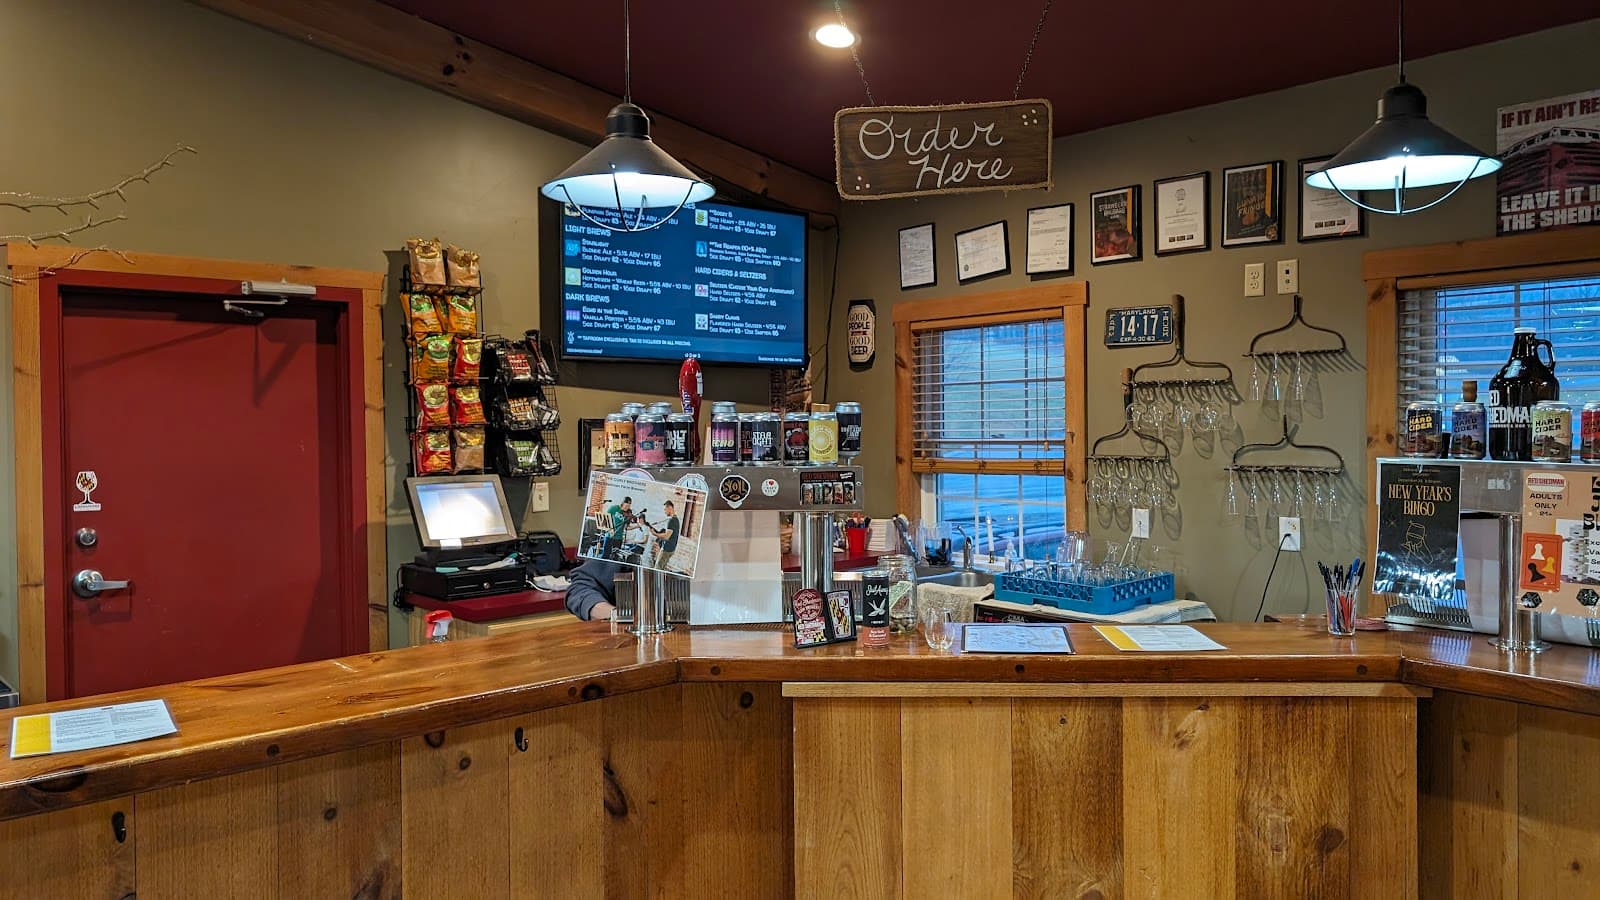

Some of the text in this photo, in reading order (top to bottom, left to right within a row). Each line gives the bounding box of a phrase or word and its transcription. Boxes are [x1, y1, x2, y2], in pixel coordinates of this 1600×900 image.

[1502, 112, 1514, 128] IF
[1518, 110, 1532, 126] IT
[1534, 101, 1577, 123] AIN'T
[859, 113, 1003, 160] Order
[908, 153, 1014, 189] Here
[1501, 190, 1560, 214] LEAVE
[1564, 186, 1584, 206] IT
[1501, 210, 1536, 232] THE
[1540, 205, 1592, 227] SHED
[565, 224, 611, 236] LIGHT BREWS
[695, 266, 711, 275] HARD
[566, 293, 610, 303] DARK BREWS
[848, 322, 870, 330] PEOPLE
[1408, 416, 1432, 427] HARD
[1454, 418, 1478, 430] HARD
[1535, 418, 1561, 427] HARD
[1408, 423, 1432, 433] CIDER
[1454, 424, 1478, 434] CIDER
[1535, 425, 1561, 434] CIDER
[1388, 484, 1452, 502] NEW YEAR'S
[1404, 500, 1435, 516] BINGO
